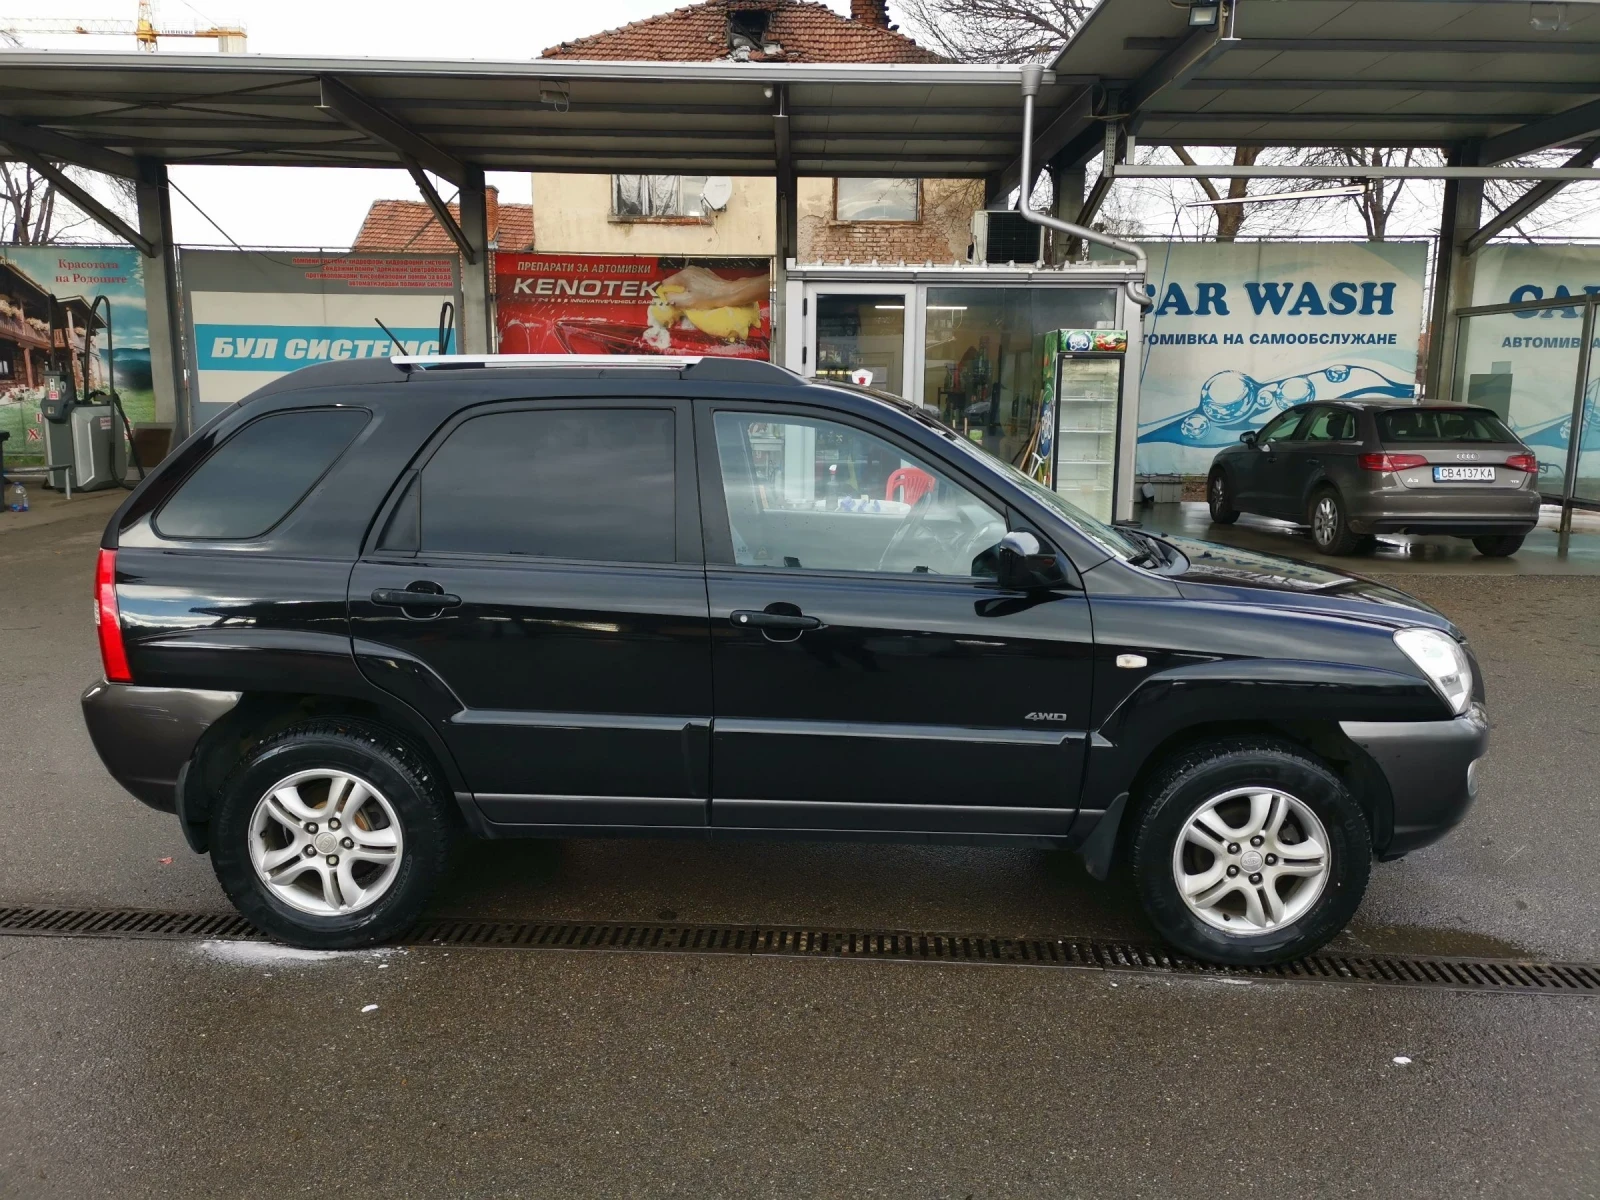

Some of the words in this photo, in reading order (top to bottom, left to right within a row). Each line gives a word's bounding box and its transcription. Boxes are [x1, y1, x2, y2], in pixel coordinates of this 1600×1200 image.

[58, 259, 119, 270] Красотата
[517, 261, 575, 272] ПРЕПАРАТИ
[576, 264, 589, 273] ЗА
[591, 264, 651, 274] АВТОМИВКИ
[55, 275, 69, 283] на
[73, 273, 128, 285] Родопите
[513, 277, 661, 297] KENOTEK
[1243, 281, 1397, 317] WASH
[1509, 284, 1600, 319] CA
[1223, 333, 1245, 345] НА
[1249, 332, 1397, 345] САМООБСЛУЖАНЕ
[1501, 336, 1600, 348] АВТОМИВА
[211, 337, 278, 359] БУЛ
[1441, 468, 1454, 478] CB
[1456, 468, 1478, 479] 4137
[1480, 468, 1494, 479] KA
[1024, 711, 1067, 721] 4WD
